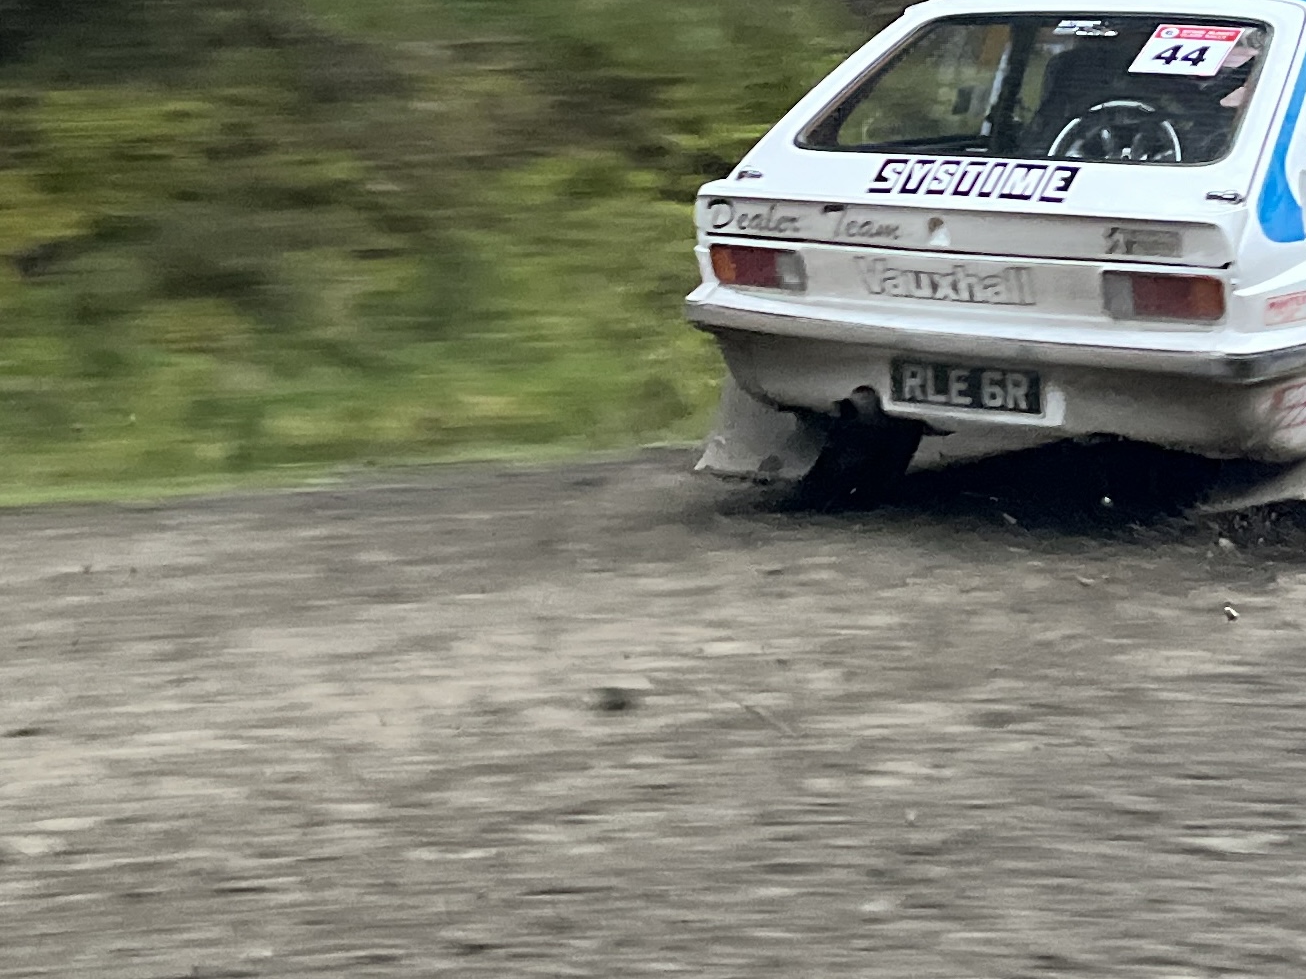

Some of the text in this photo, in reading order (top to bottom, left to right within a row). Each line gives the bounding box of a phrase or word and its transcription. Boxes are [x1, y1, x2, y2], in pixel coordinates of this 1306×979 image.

[1152, 44, 1211, 66] 44
[866, 159, 1082, 203] SYSTIME
[707, 198, 900, 239] Dealer Team
[853, 256, 1037, 306] Vauxhall
[902, 363, 1028, 410] RLE 6R
